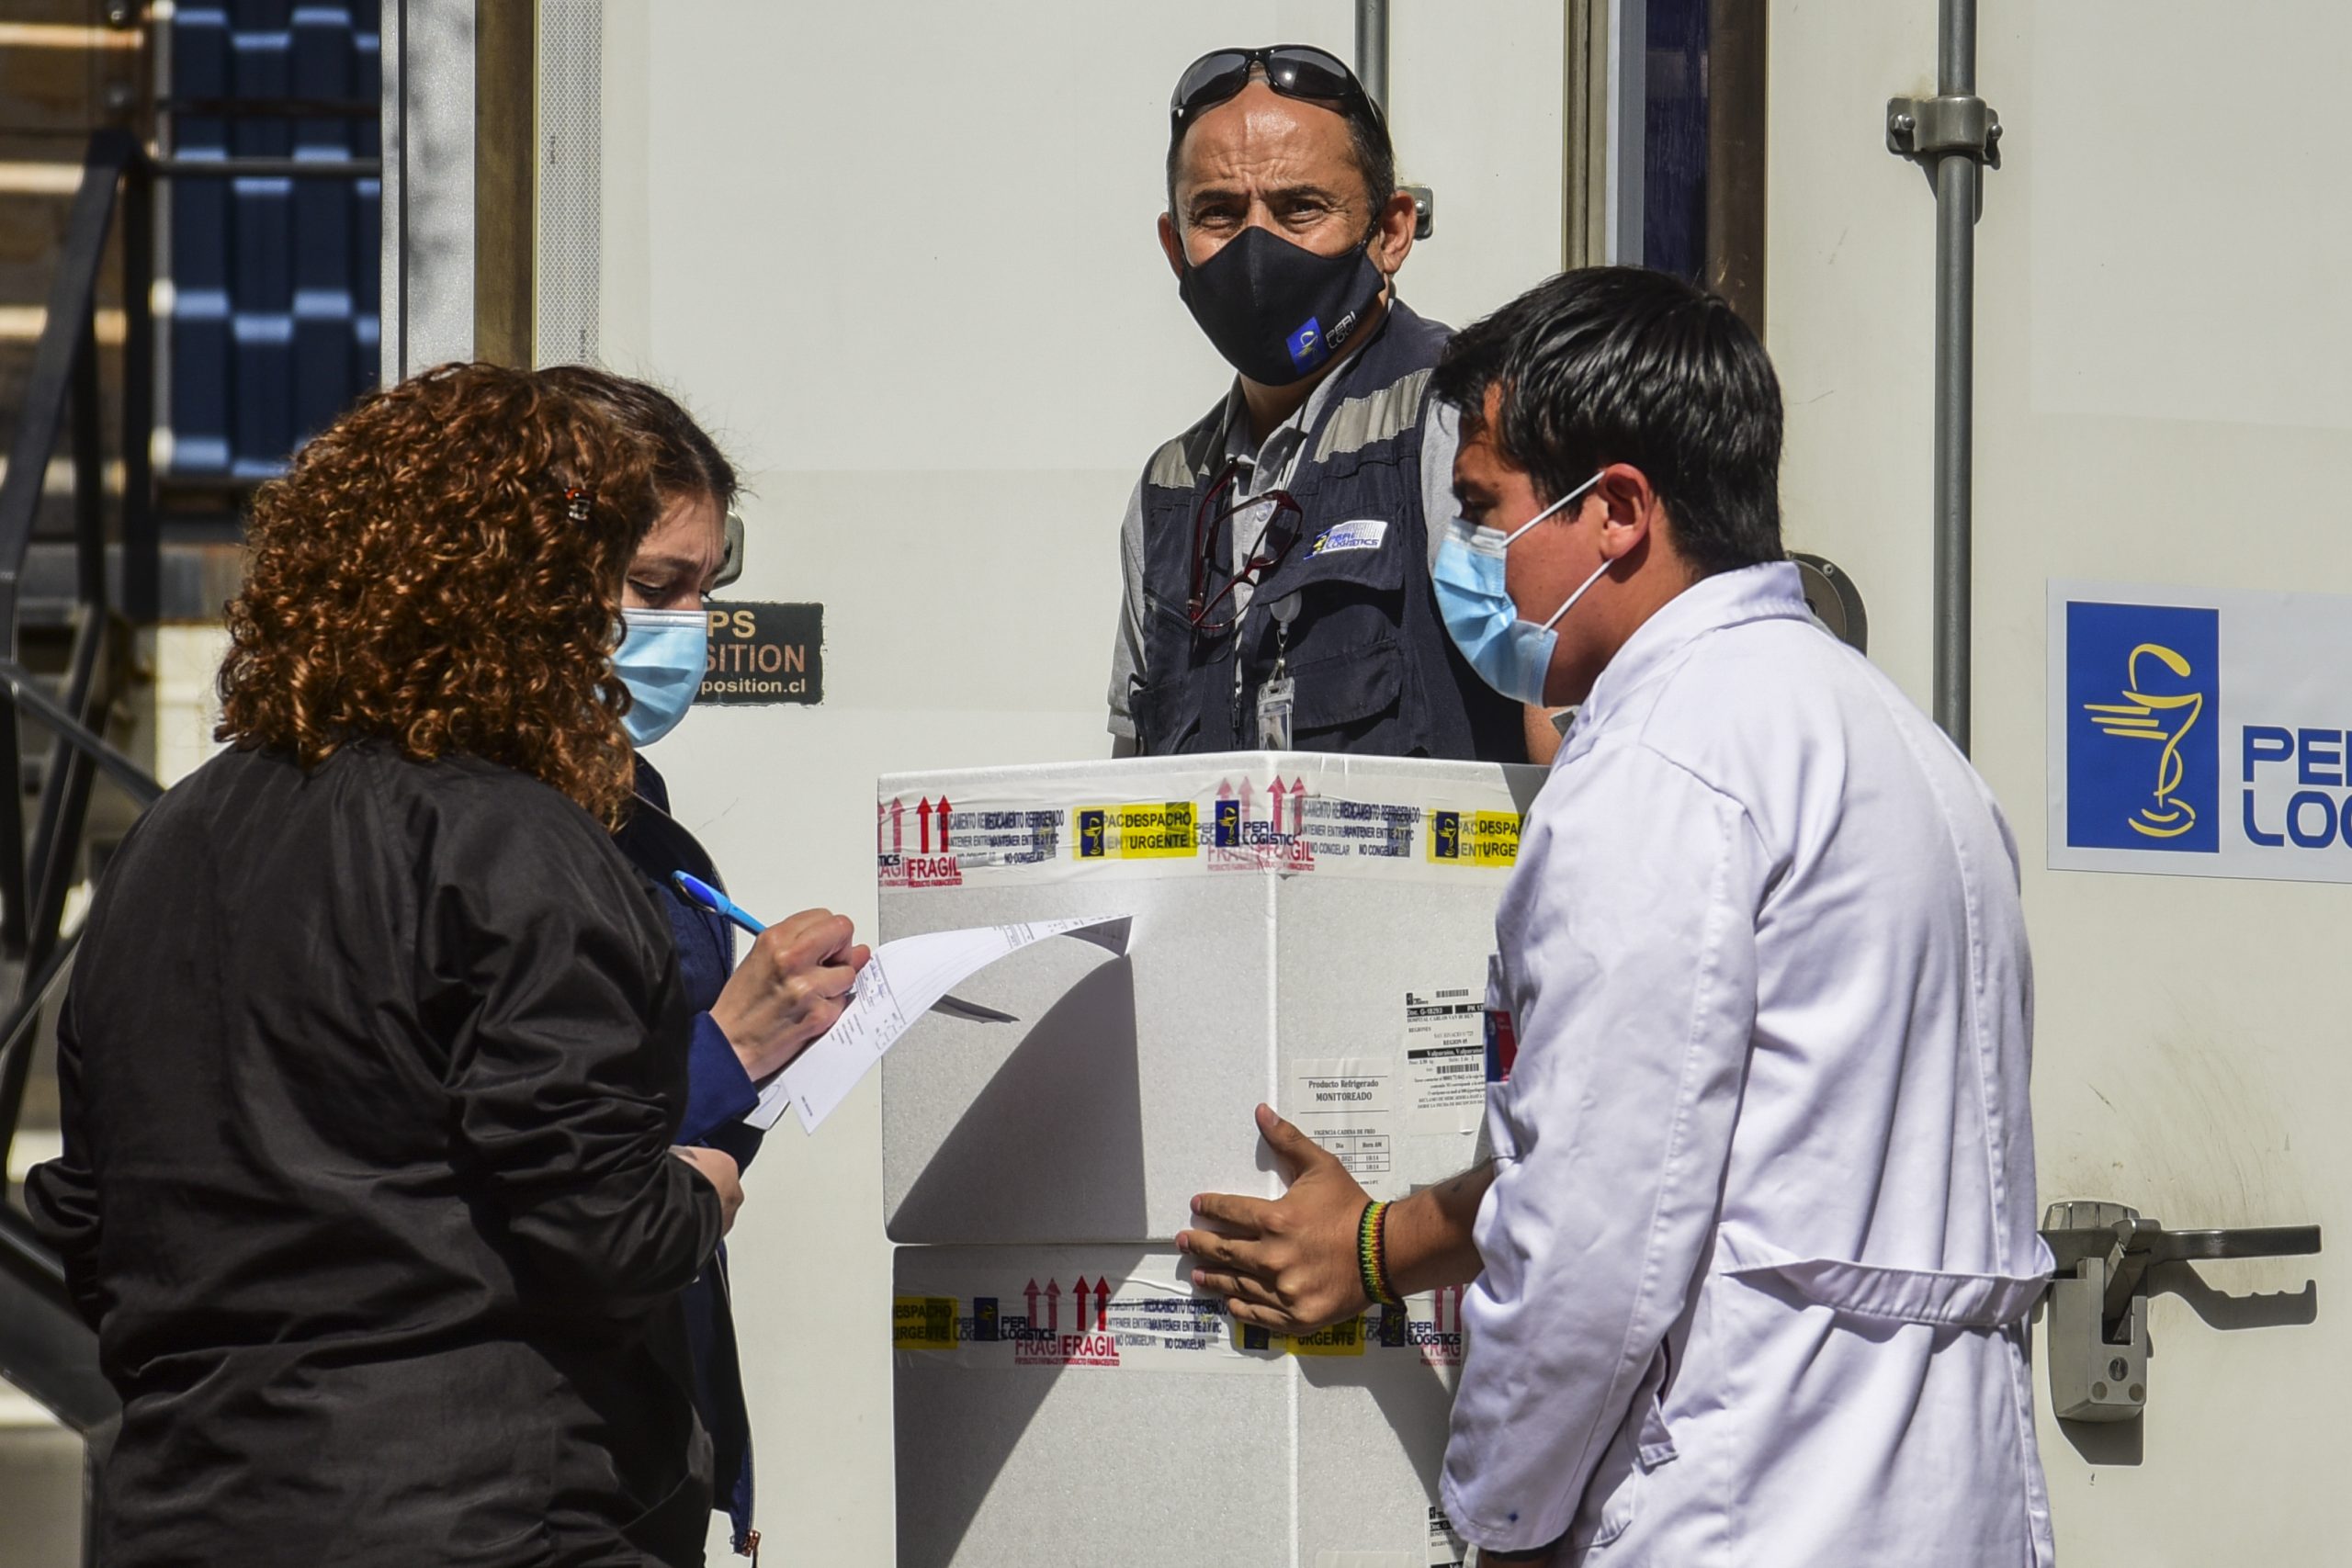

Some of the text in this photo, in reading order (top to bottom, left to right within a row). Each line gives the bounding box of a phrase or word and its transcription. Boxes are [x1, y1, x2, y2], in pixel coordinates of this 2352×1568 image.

[707, 610, 756, 637] PS
[707, 644, 805, 672] SITION
[701, 678, 806, 695] position.cl
[2243, 725, 2352, 787] PE
[1125, 812, 1192, 828] DESPACHO
[2243, 789, 2352, 850] LO
[1243, 821, 1274, 834] PERI
[1479, 820, 1521, 836] DESPA
[1129, 833, 1188, 849] URGENTE
[1483, 842, 1518, 857] URGE
[909, 857, 962, 878] FRAGIL
[1308, 1078, 1379, 1089] Producto Refrigerado
[1316, 1091, 1373, 1102] MONITOREADO
[894, 1304, 952, 1319] ESPACHO
[1001, 1316, 1030, 1328] PERI
[1408, 1321, 1436, 1333] PERI
[1001, 1328, 1056, 1340] LOGISTICS
[1408, 1333, 1461, 1345] LOGISTICS
[1063, 1334, 1119, 1357] FRAGIL
[1165, 1337, 1206, 1350] NO CONGELAR
